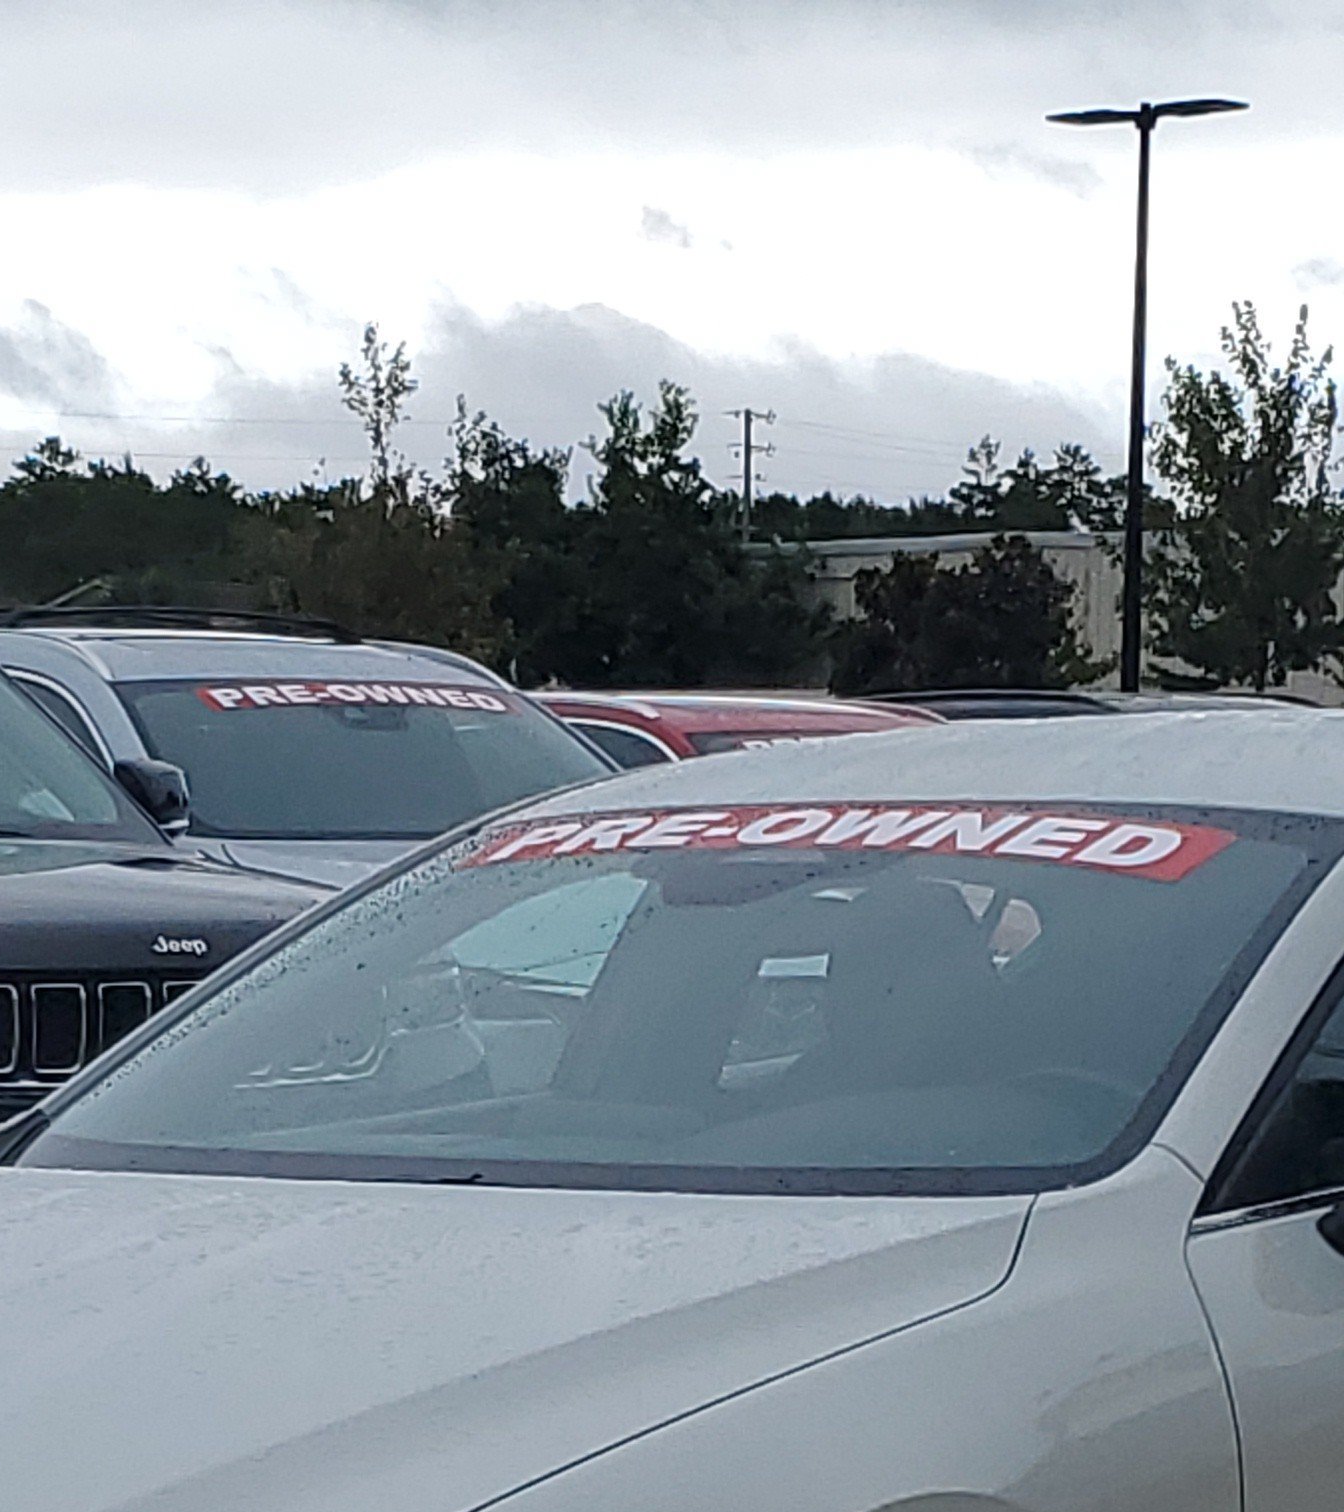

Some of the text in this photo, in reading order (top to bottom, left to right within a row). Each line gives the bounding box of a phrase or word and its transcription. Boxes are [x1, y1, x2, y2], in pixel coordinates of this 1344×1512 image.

[208, 685, 506, 711] PRE-OWNED
[489, 808, 1183, 867] PRE-OWNED
[152, 935, 208, 956] Jeep
